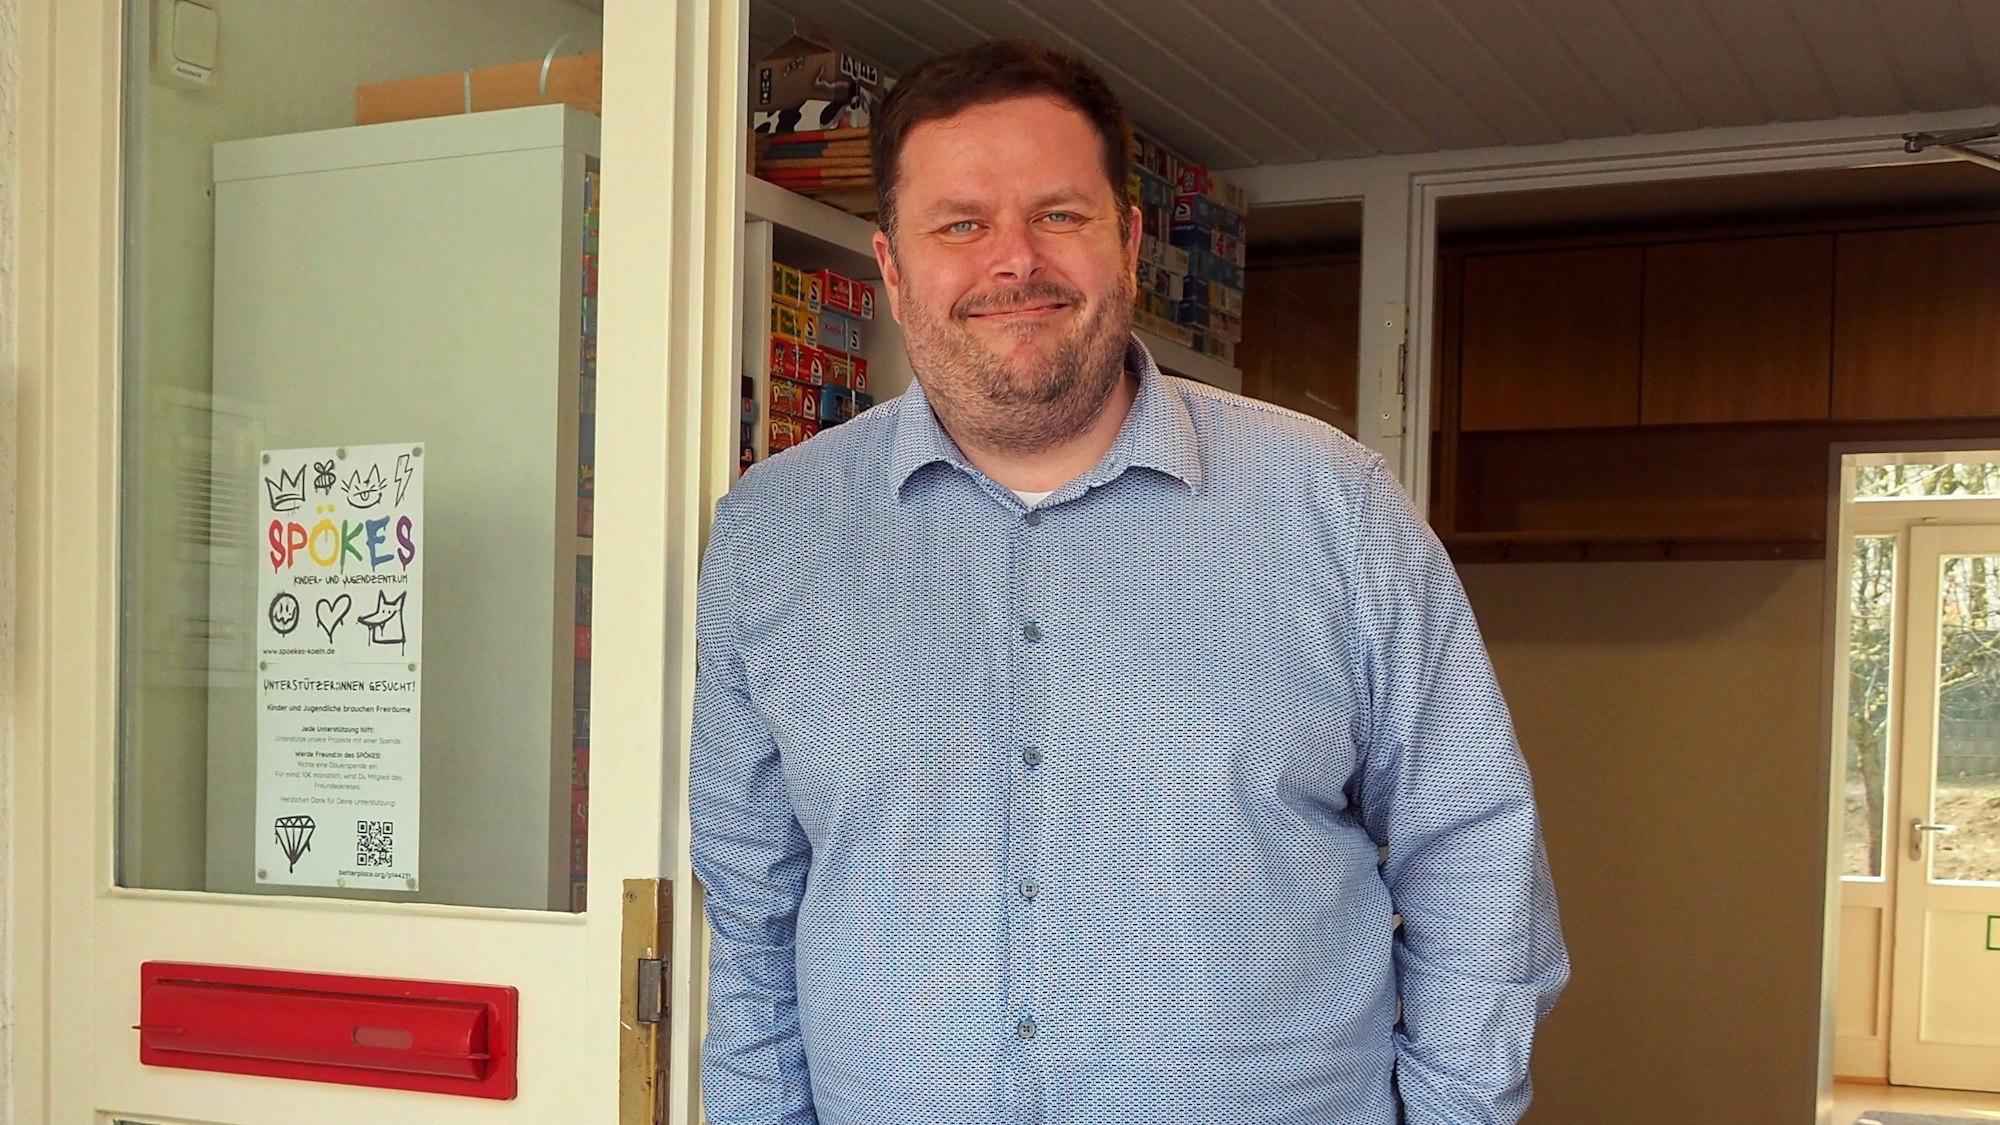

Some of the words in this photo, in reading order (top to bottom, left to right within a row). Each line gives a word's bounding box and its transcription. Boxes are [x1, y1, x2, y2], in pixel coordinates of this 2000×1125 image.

[269, 504, 415, 573] SPÖKES
[294, 575, 322, 585] KINDER-
[325, 576, 339, 584] UND
[343, 575, 408, 586] JUGENDZENTRUM
[263, 678, 364, 691] UNTERSTÜTZER:INNEN
[368, 680, 415, 692] GESUCHT!
[303, 704, 341, 713] Jugendliche
[343, 705, 374, 713] brauchen
[376, 705, 411, 713] Freiräume
[317, 726, 359, 734] Unterstützung
[274, 735, 306, 743] Unterstütze
[328, 736, 352, 744] Projekte
[329, 762, 367, 770] Dauerspende
[368, 773, 390, 781] Mitglied
[337, 797, 352, 805] Deine
